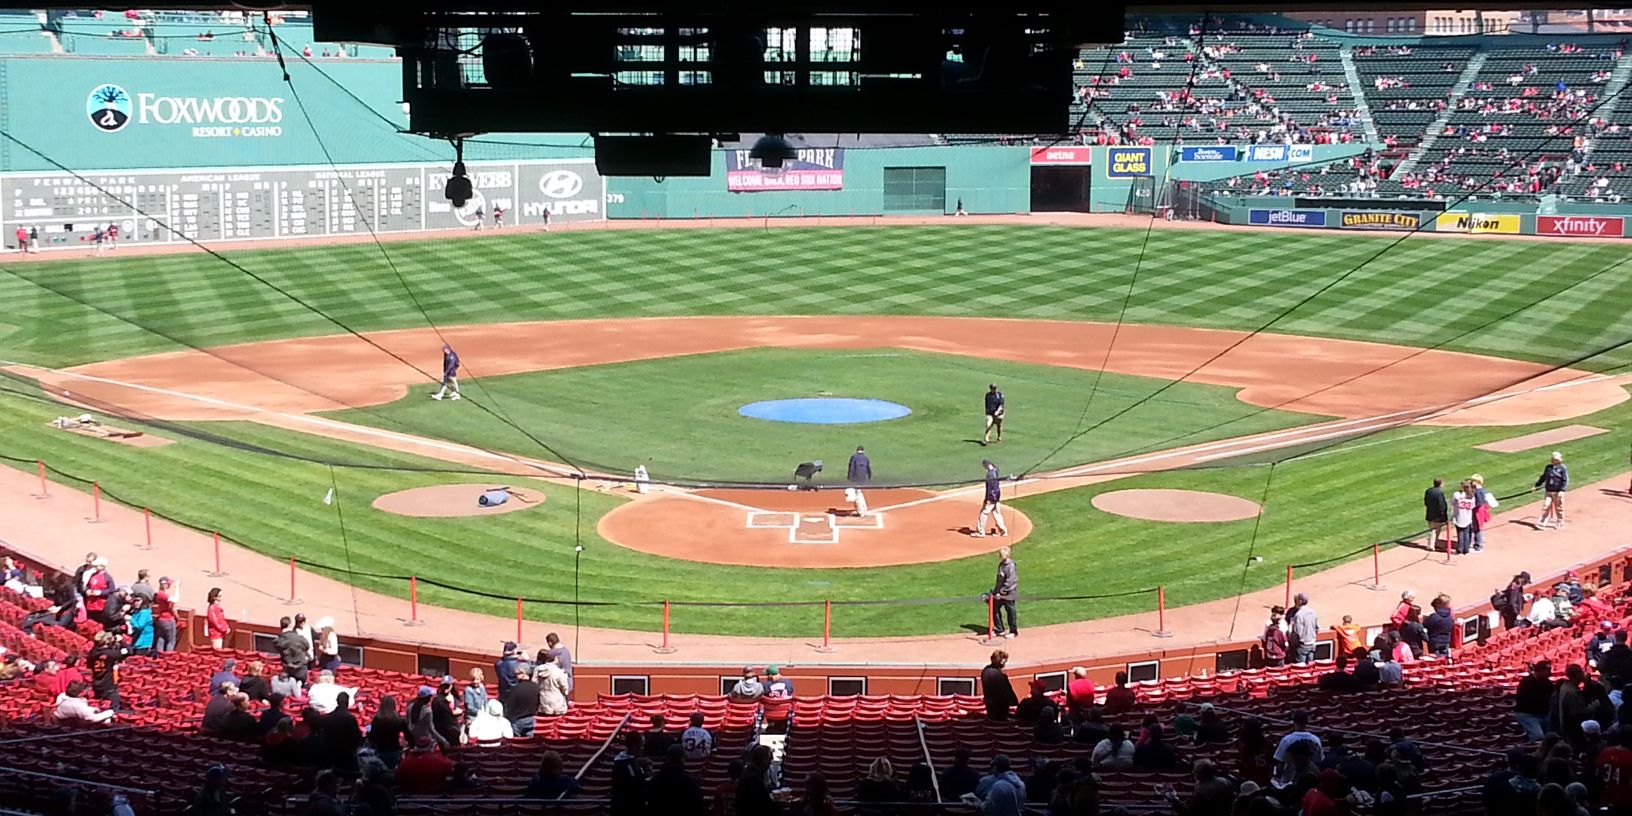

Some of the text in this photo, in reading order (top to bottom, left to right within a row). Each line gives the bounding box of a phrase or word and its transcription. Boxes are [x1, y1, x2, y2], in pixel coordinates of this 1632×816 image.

[192, 126, 282, 137] RESORT CASINO
[798, 149, 835, 168] PARK
[1046, 151, 1075, 160] aetna
[1114, 152, 1145, 163] GIANT
[1253, 147, 1285, 160] NESN
[1113, 163, 1146, 173] GLASS
[34, 178, 91, 186] FENWAY
[227, 173, 261, 181] LEAGUE
[728, 175, 763, 186] WELCOME
[785, 175, 800, 185] RED
[801, 174, 816, 185] SOX
[817, 174, 843, 185] NATION
[1136, 188, 1150, 197] 420
[77, 207, 108, 215] 2014
[523, 200, 598, 215] HYUNDAI
[1268, 210, 1307, 224] jetBlue
[1343, 213, 1392, 226] GRANITE
[1393, 213, 1418, 227] CITY
[1456, 216, 1500, 230] Nikon
[1553, 217, 1605, 234] xfinity
[685, 737, 706, 751] 34
[1254, 754, 1266, 766] 15
[1602, 764, 1620, 783] 34
